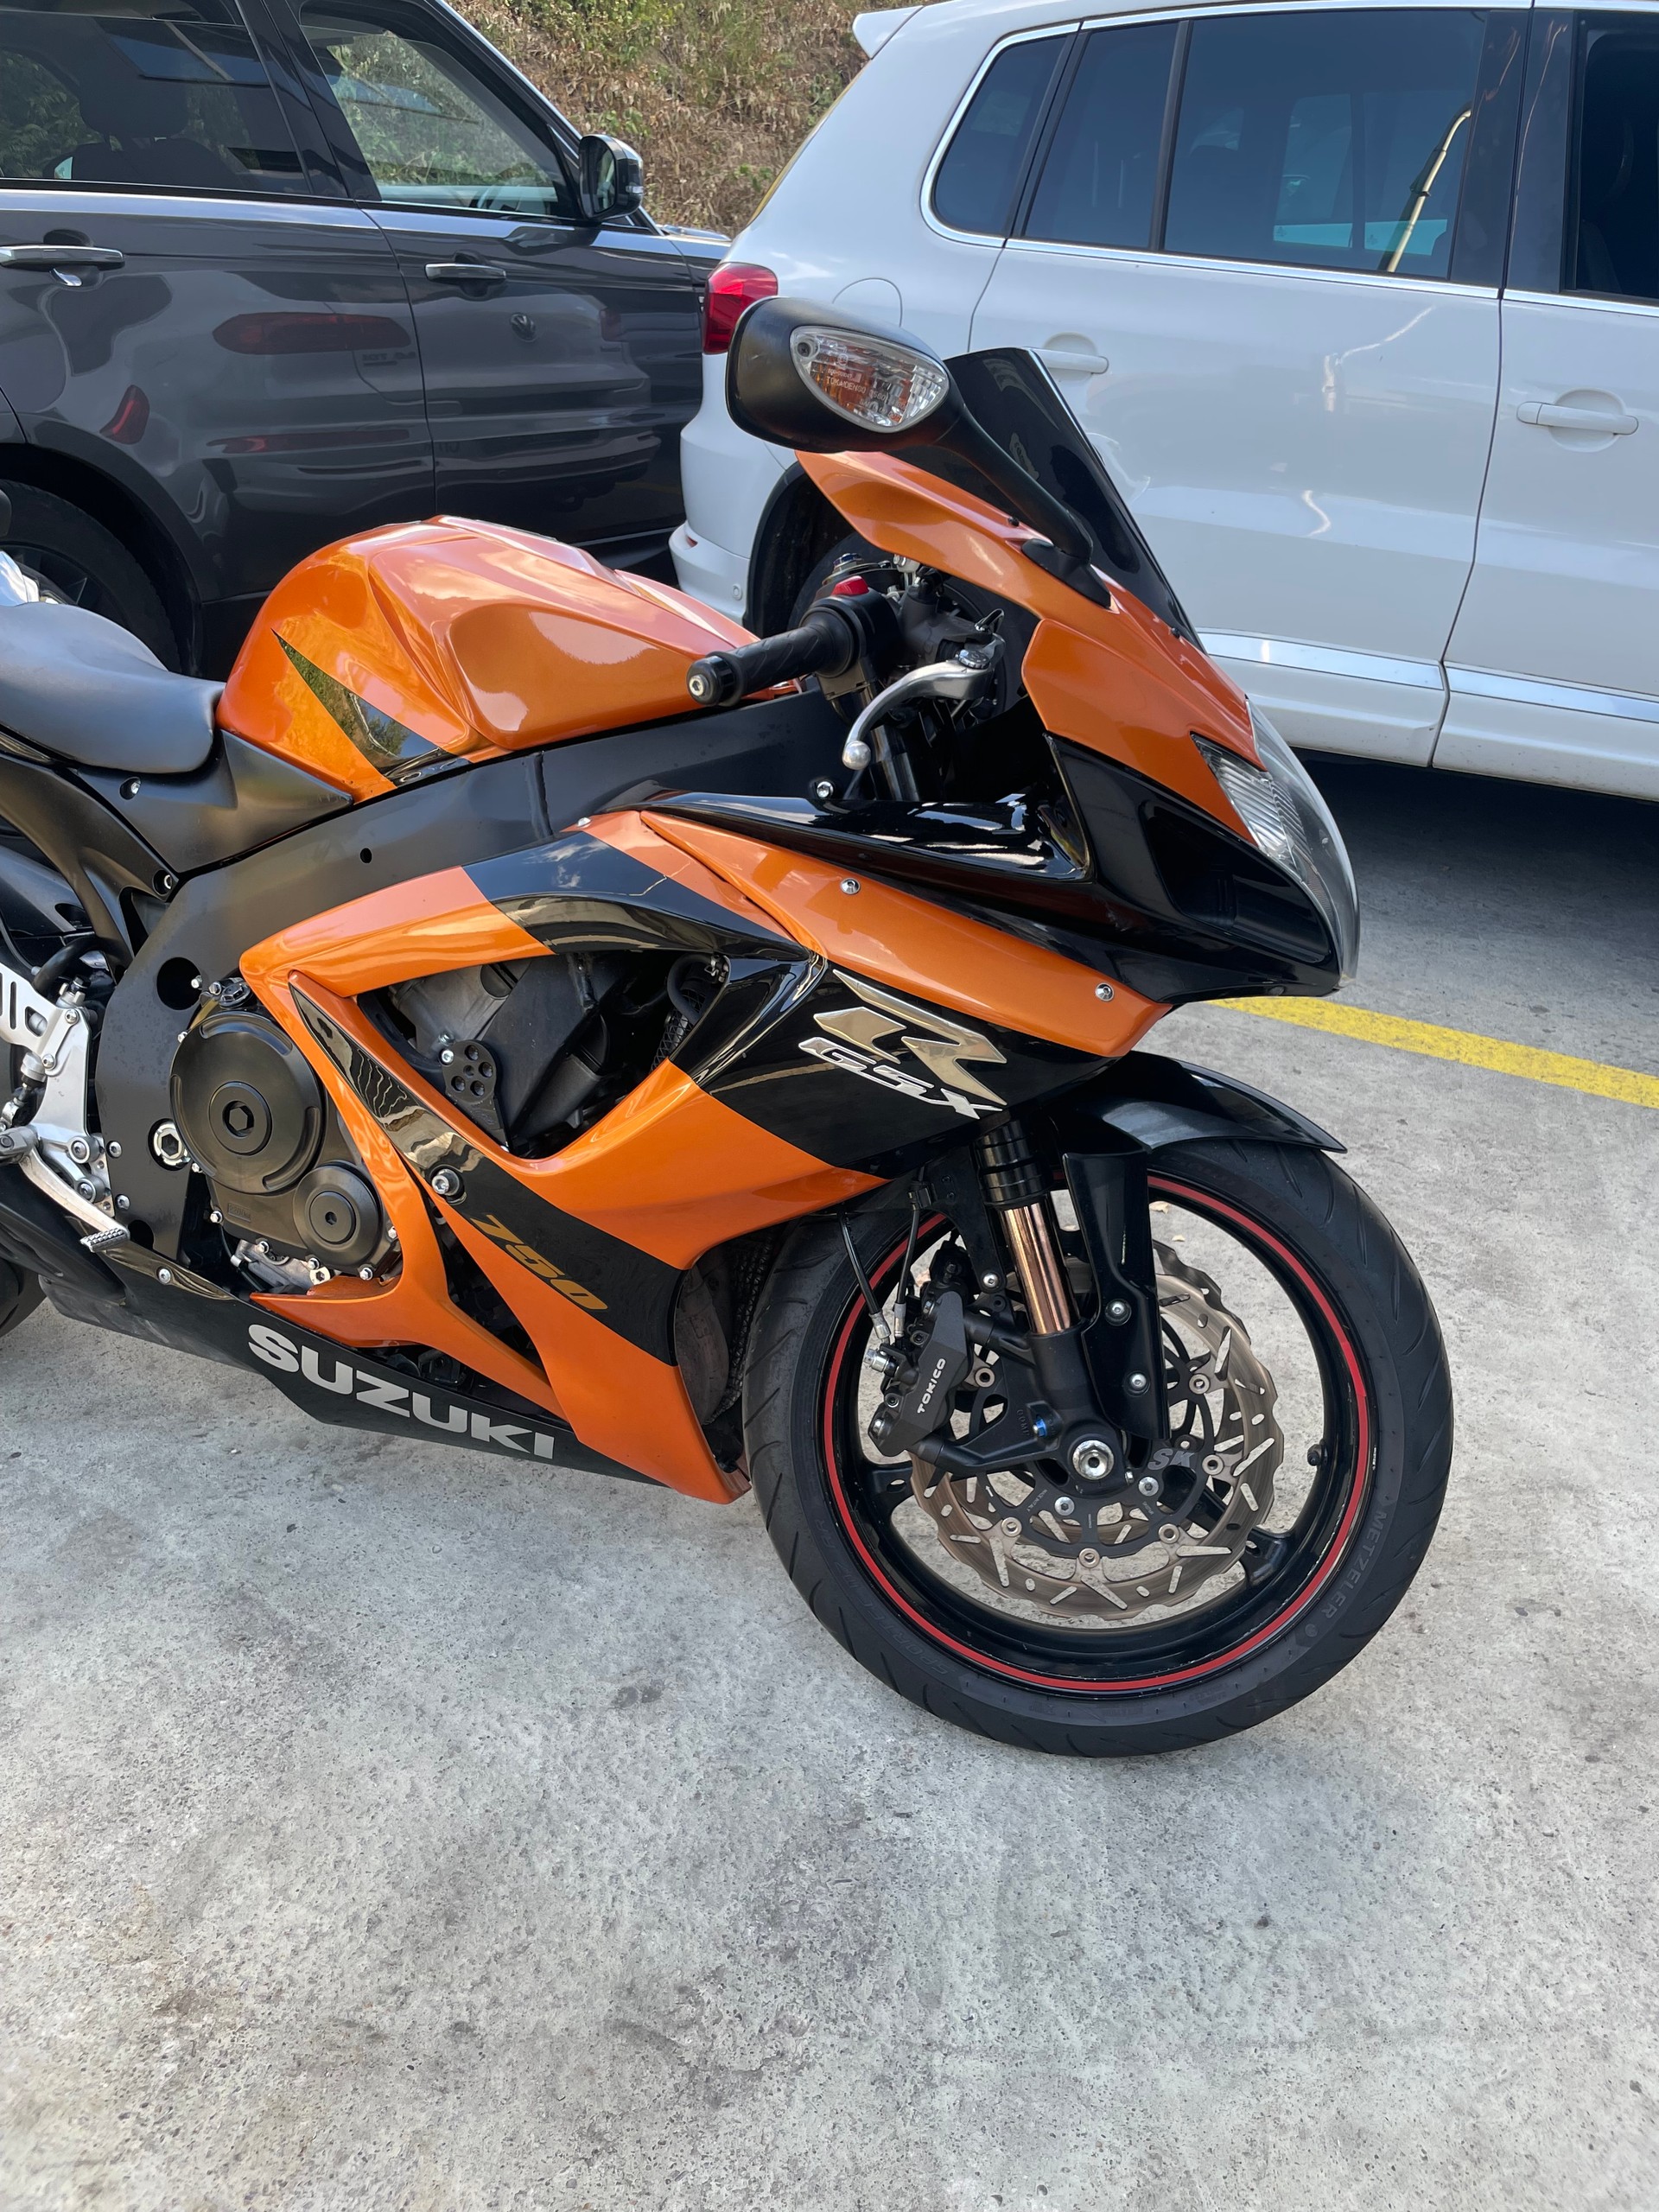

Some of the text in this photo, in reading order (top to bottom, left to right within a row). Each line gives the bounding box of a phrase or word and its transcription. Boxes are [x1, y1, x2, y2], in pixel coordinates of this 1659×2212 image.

[469, 1214, 608, 1310] 750
[247, 1324, 555, 1459] SUZUKI
[917, 1357, 946, 1414] TOKICO
[1147, 1448, 1195, 1471] SK
[1321, 1511, 1387, 1618] METZELER
